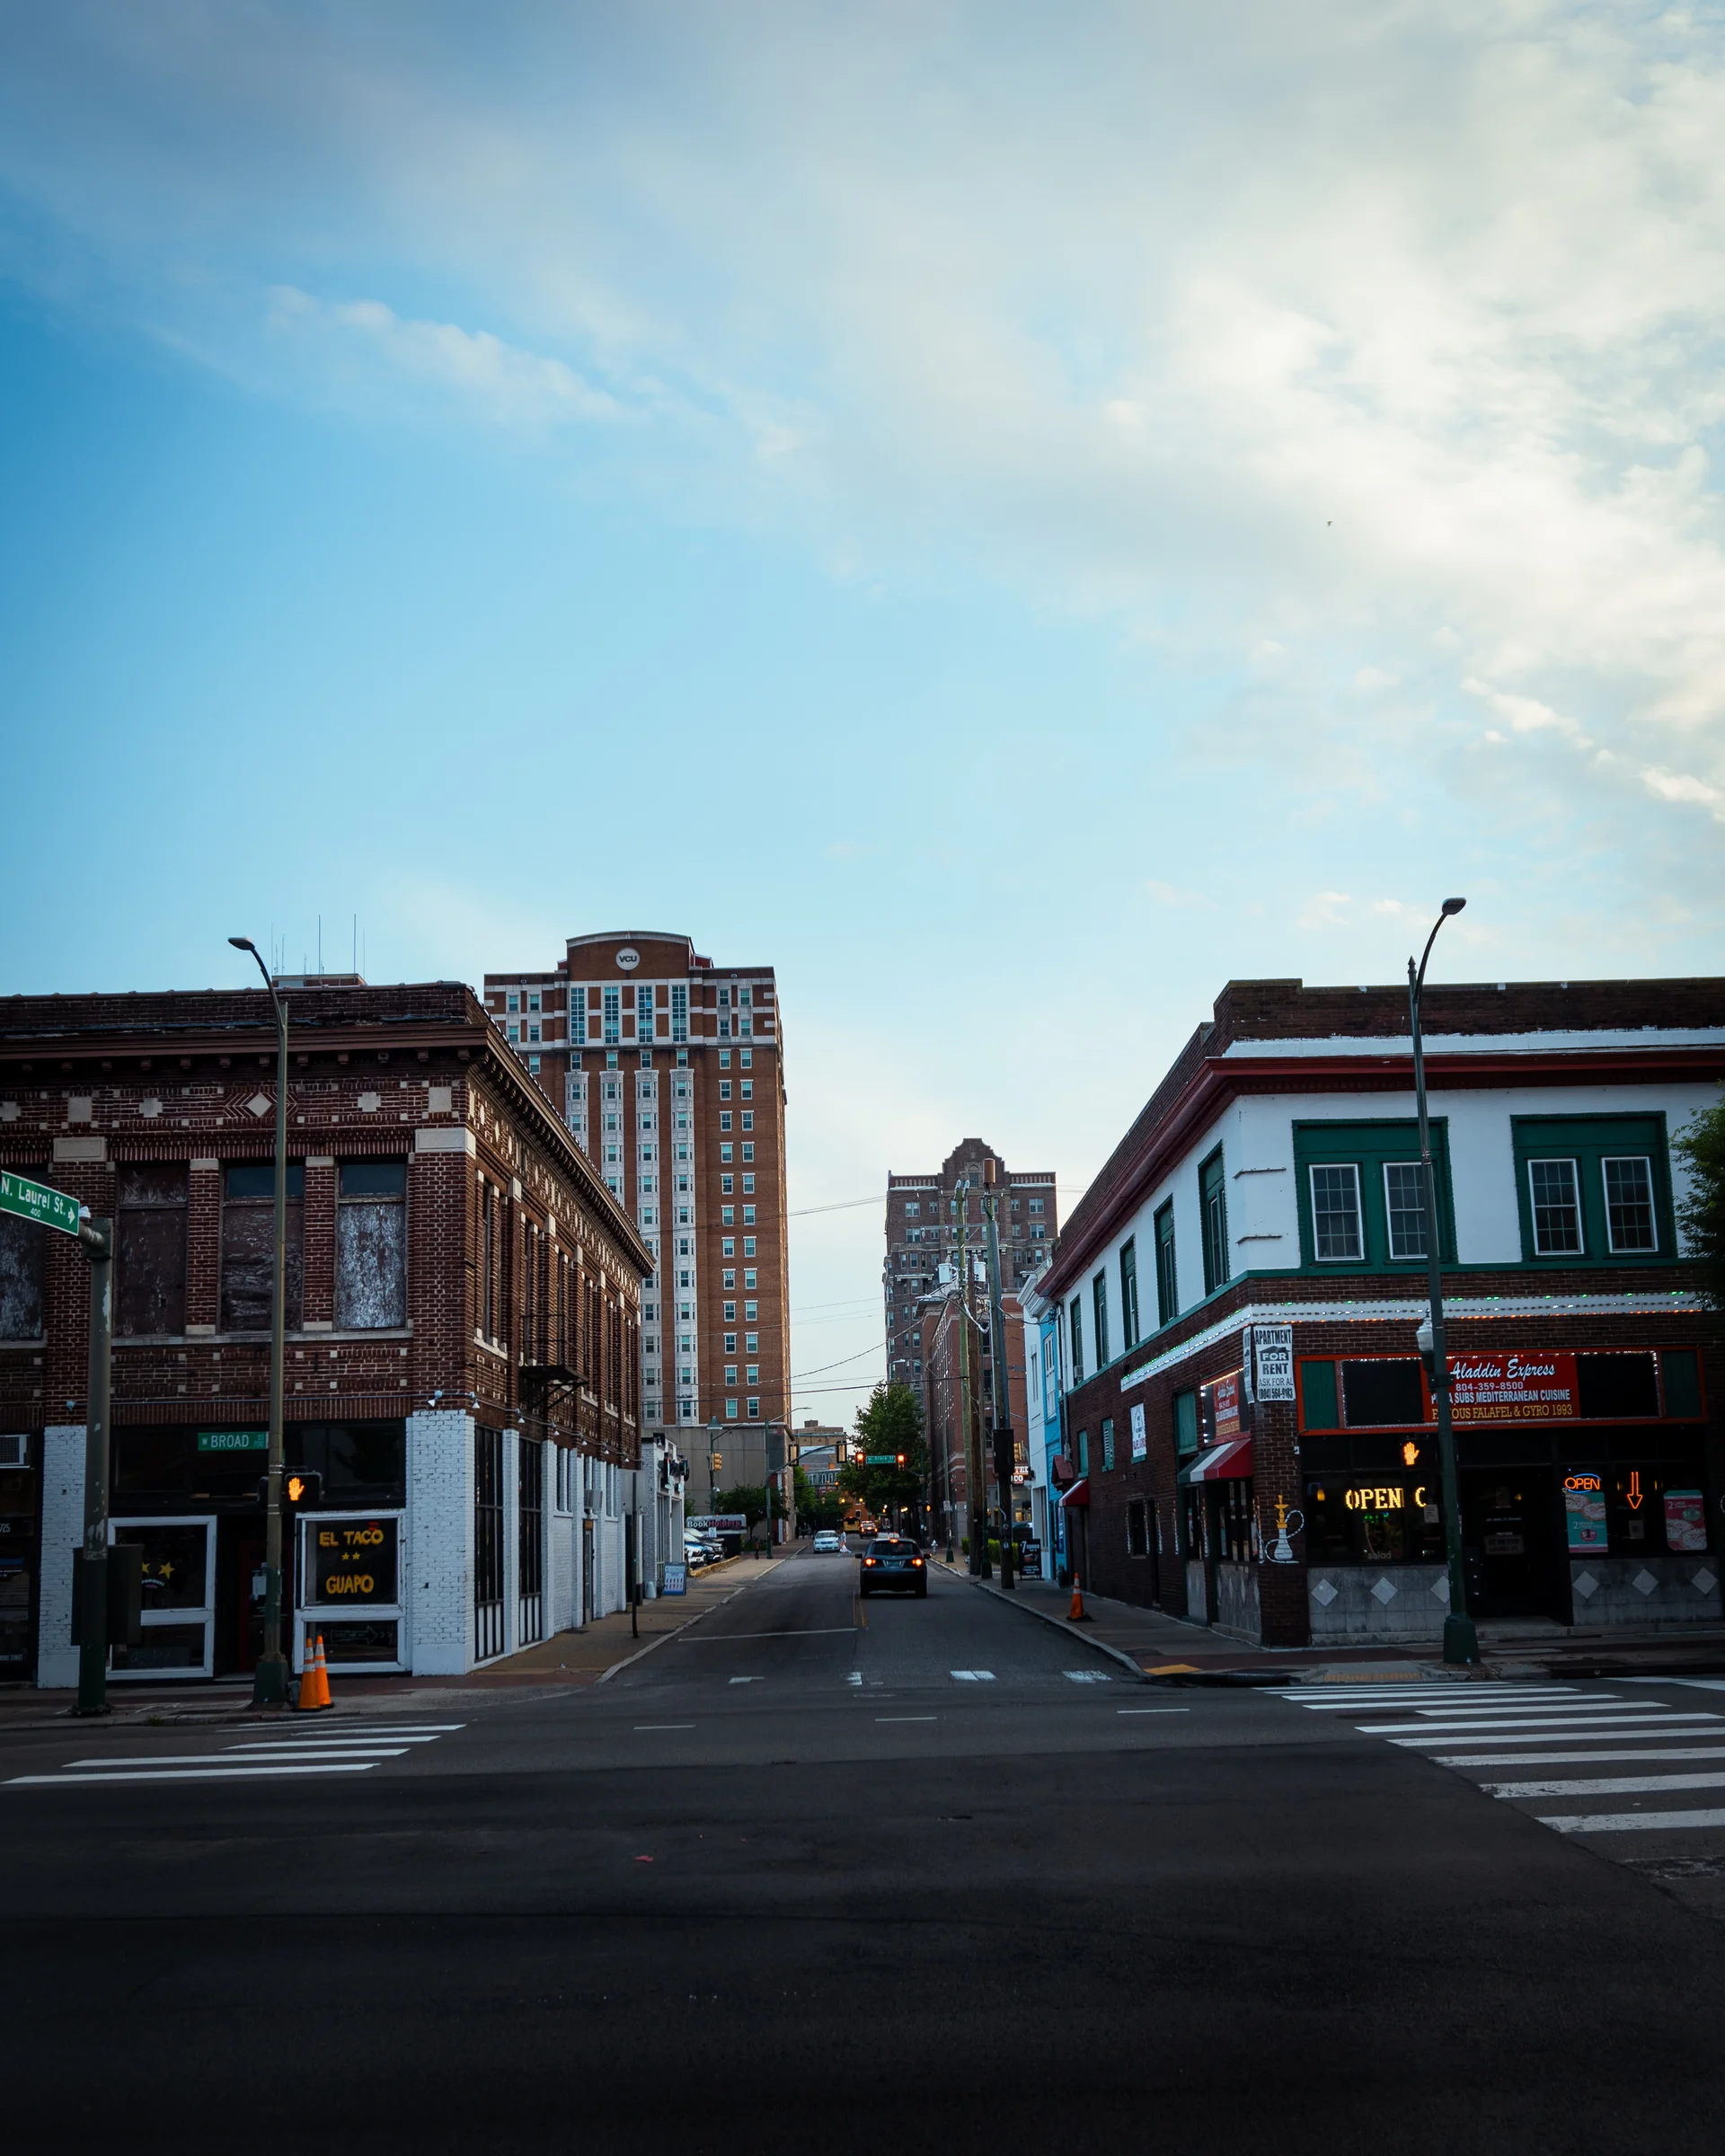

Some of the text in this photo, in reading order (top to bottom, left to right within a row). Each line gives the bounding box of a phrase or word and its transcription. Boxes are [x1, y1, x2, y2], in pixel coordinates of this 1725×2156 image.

[618, 955, 637, 963] VCU
[1, 1176, 66, 1216] N. Laurel St.
[30, 1207, 41, 1218] 400
[1255, 1330, 1291, 1344] APARTMENT
[1262, 1352, 1287, 1361] FOR
[1262, 1363, 1288, 1375] RENT
[1450, 1358, 1555, 1381] Aladdin Express
[1258, 1378, 1271, 1387] ASK
[1272, 1377, 1285, 1386] FOR
[1455, 1381, 1524, 1392] 804-359-8500
[1476, 1390, 1539, 1403] MEDITERRANEAN
[1540, 1389, 1570, 1401] CUISINE
[1432, 1403, 1573, 1420] FOUS FALAFEL & GYRO 1993
[201, 1437, 208, 1445] W
[210, 1435, 249, 1448] BROAD
[1564, 1477, 1600, 1490] OPEN
[1345, 1487, 1404, 1509] OPEN
[687, 1518, 741, 1528] BookHolders
[319, 1529, 384, 1547] EL TACO
[1367, 1551, 1392, 1560] salad
[325, 1574, 375, 1595] GUAPO
